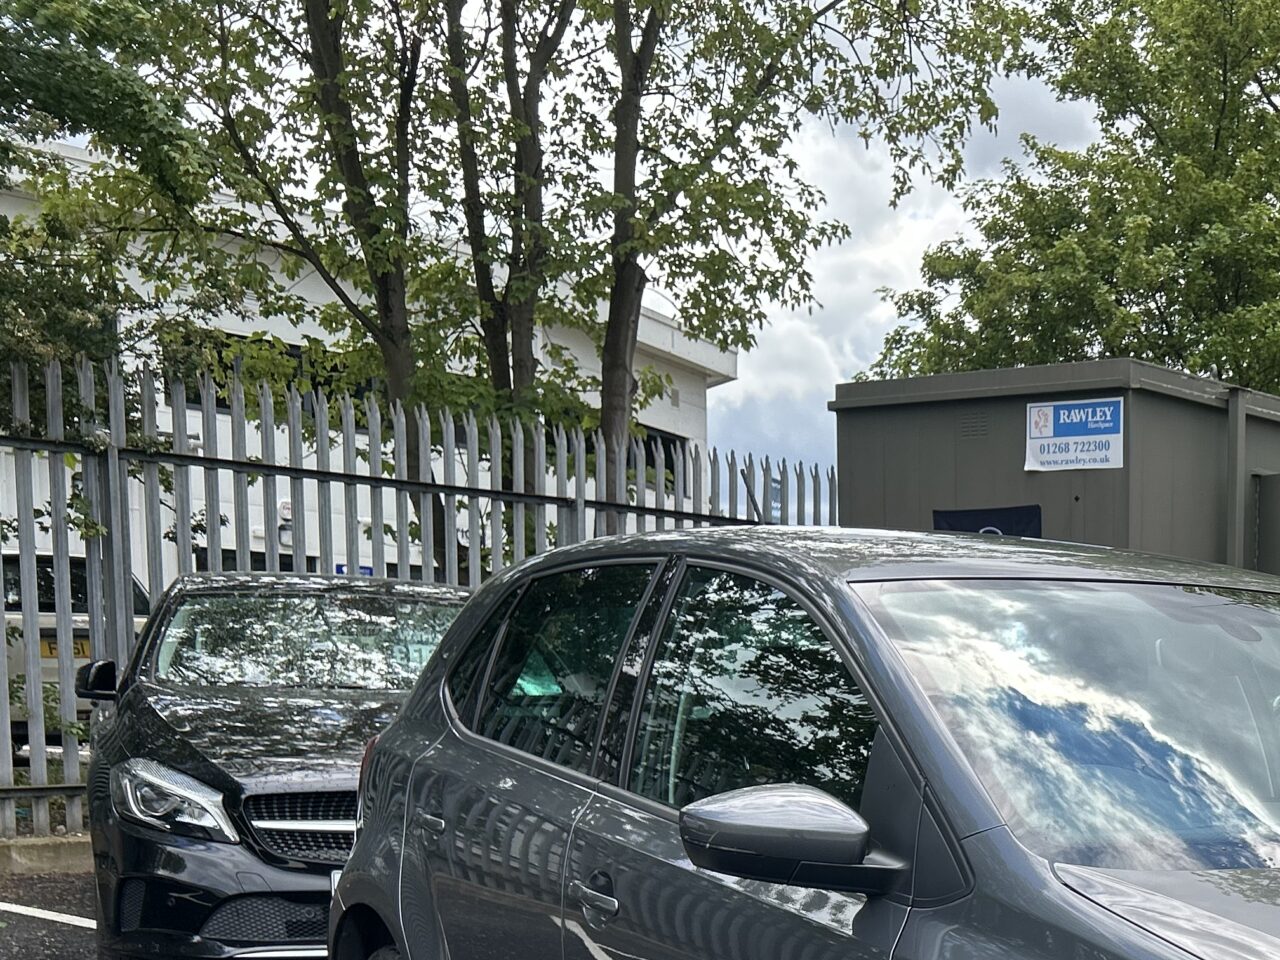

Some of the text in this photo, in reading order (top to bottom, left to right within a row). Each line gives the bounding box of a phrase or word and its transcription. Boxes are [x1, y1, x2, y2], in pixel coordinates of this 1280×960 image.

[1059, 407, 1113, 423] RAWLEY
[1040, 440, 1111, 455] 01268 722300
[1040, 454, 1110, 466] www.rawley.co.uk
